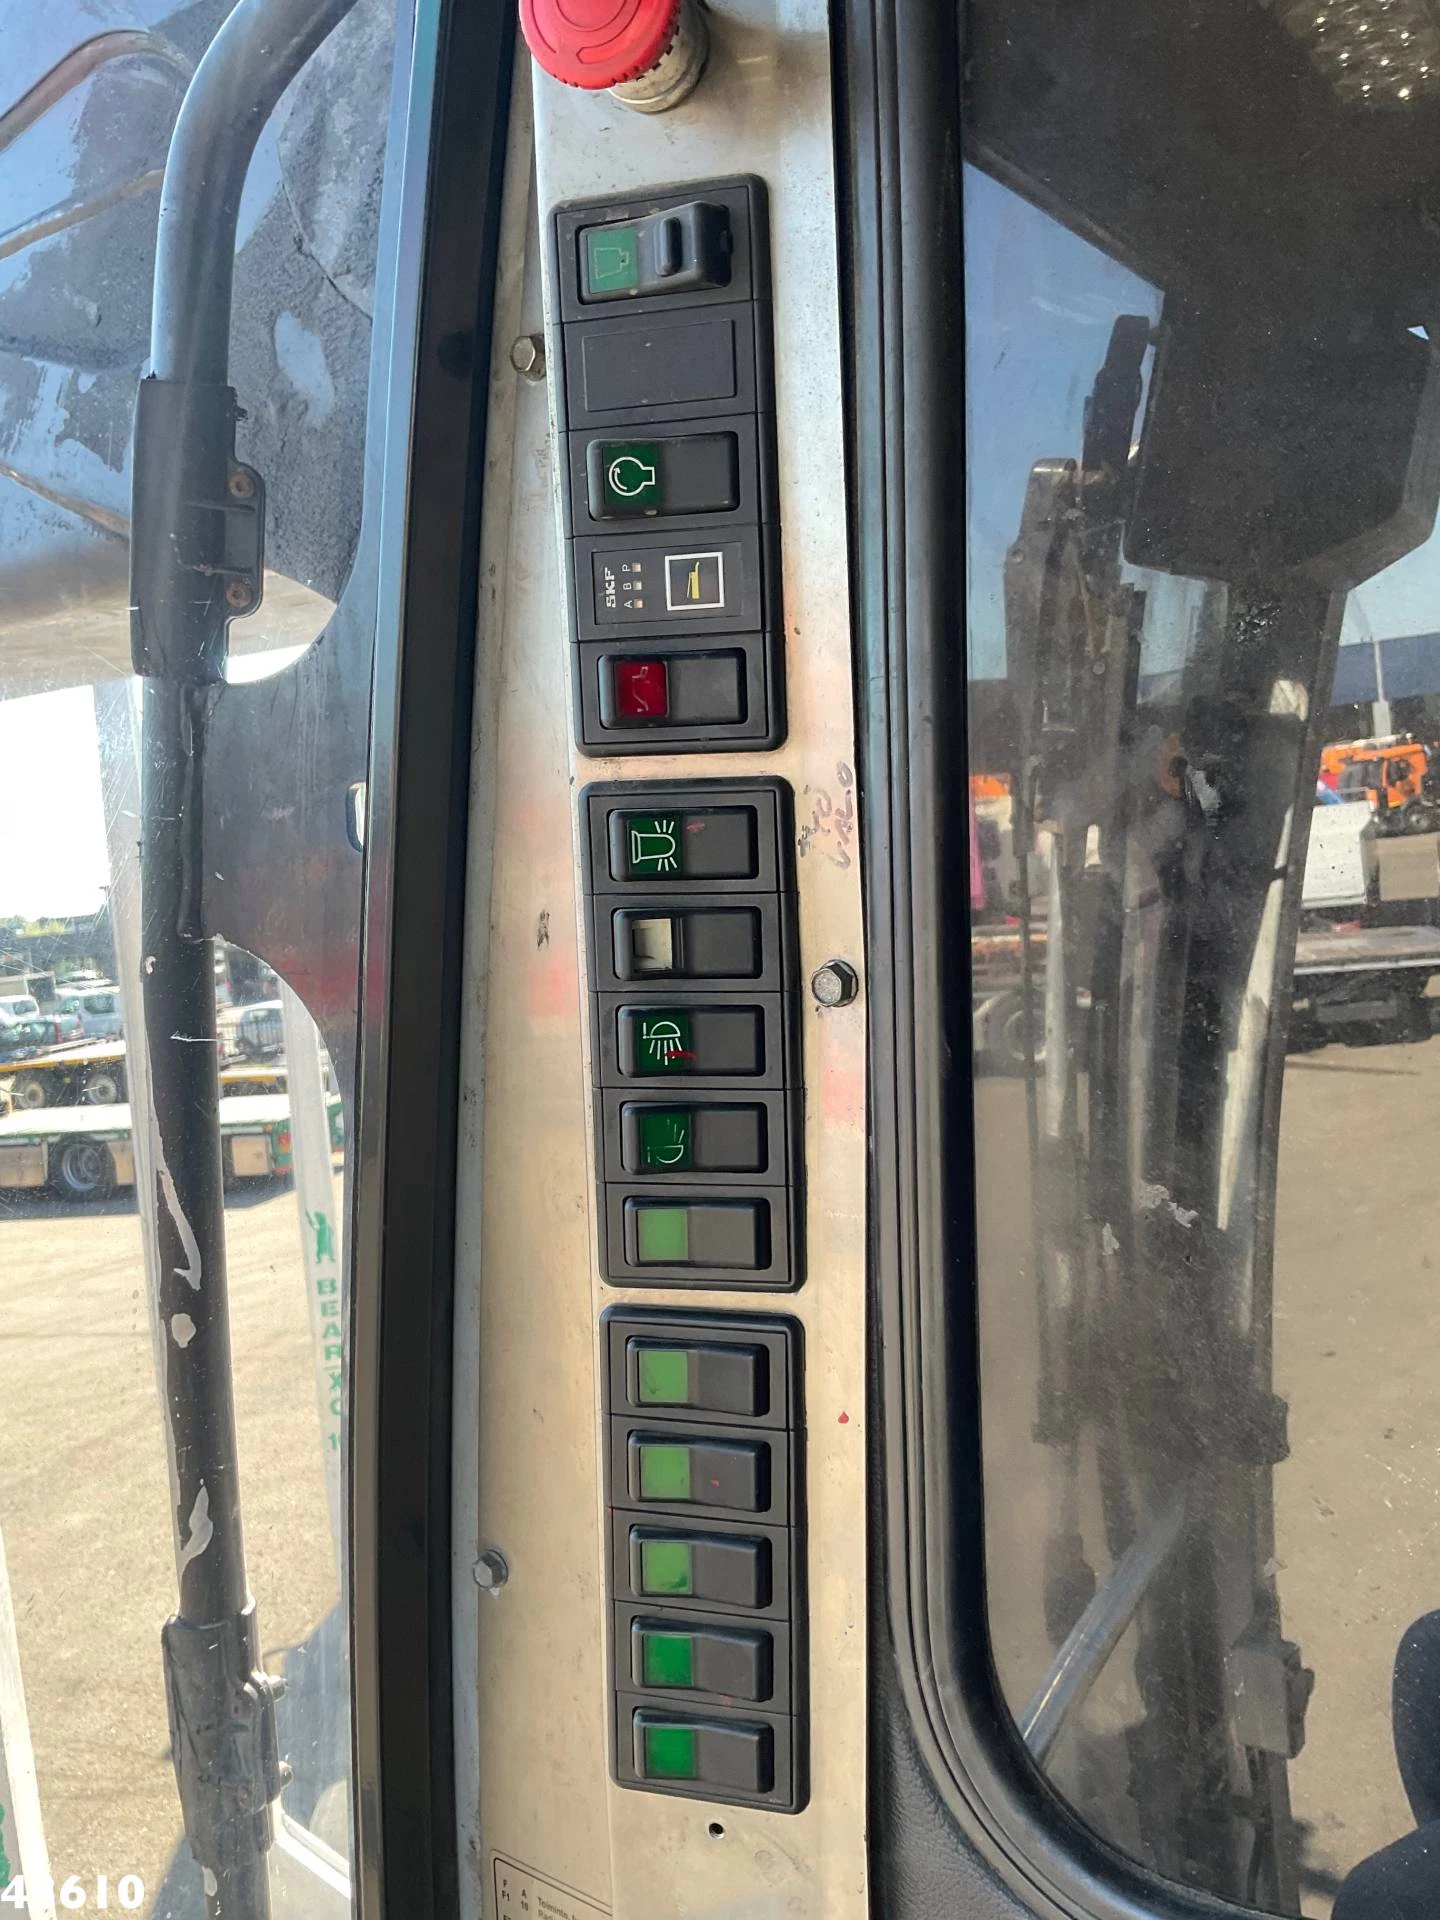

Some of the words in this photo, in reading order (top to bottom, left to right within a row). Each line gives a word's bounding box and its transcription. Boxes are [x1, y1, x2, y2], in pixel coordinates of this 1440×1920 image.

[622, 564, 631, 572] P
[604, 567, 616, 608] SKF
[623, 582, 632, 590] B
[623, 600, 633, 609] A
[316, 1278, 342, 1361] BEAR
